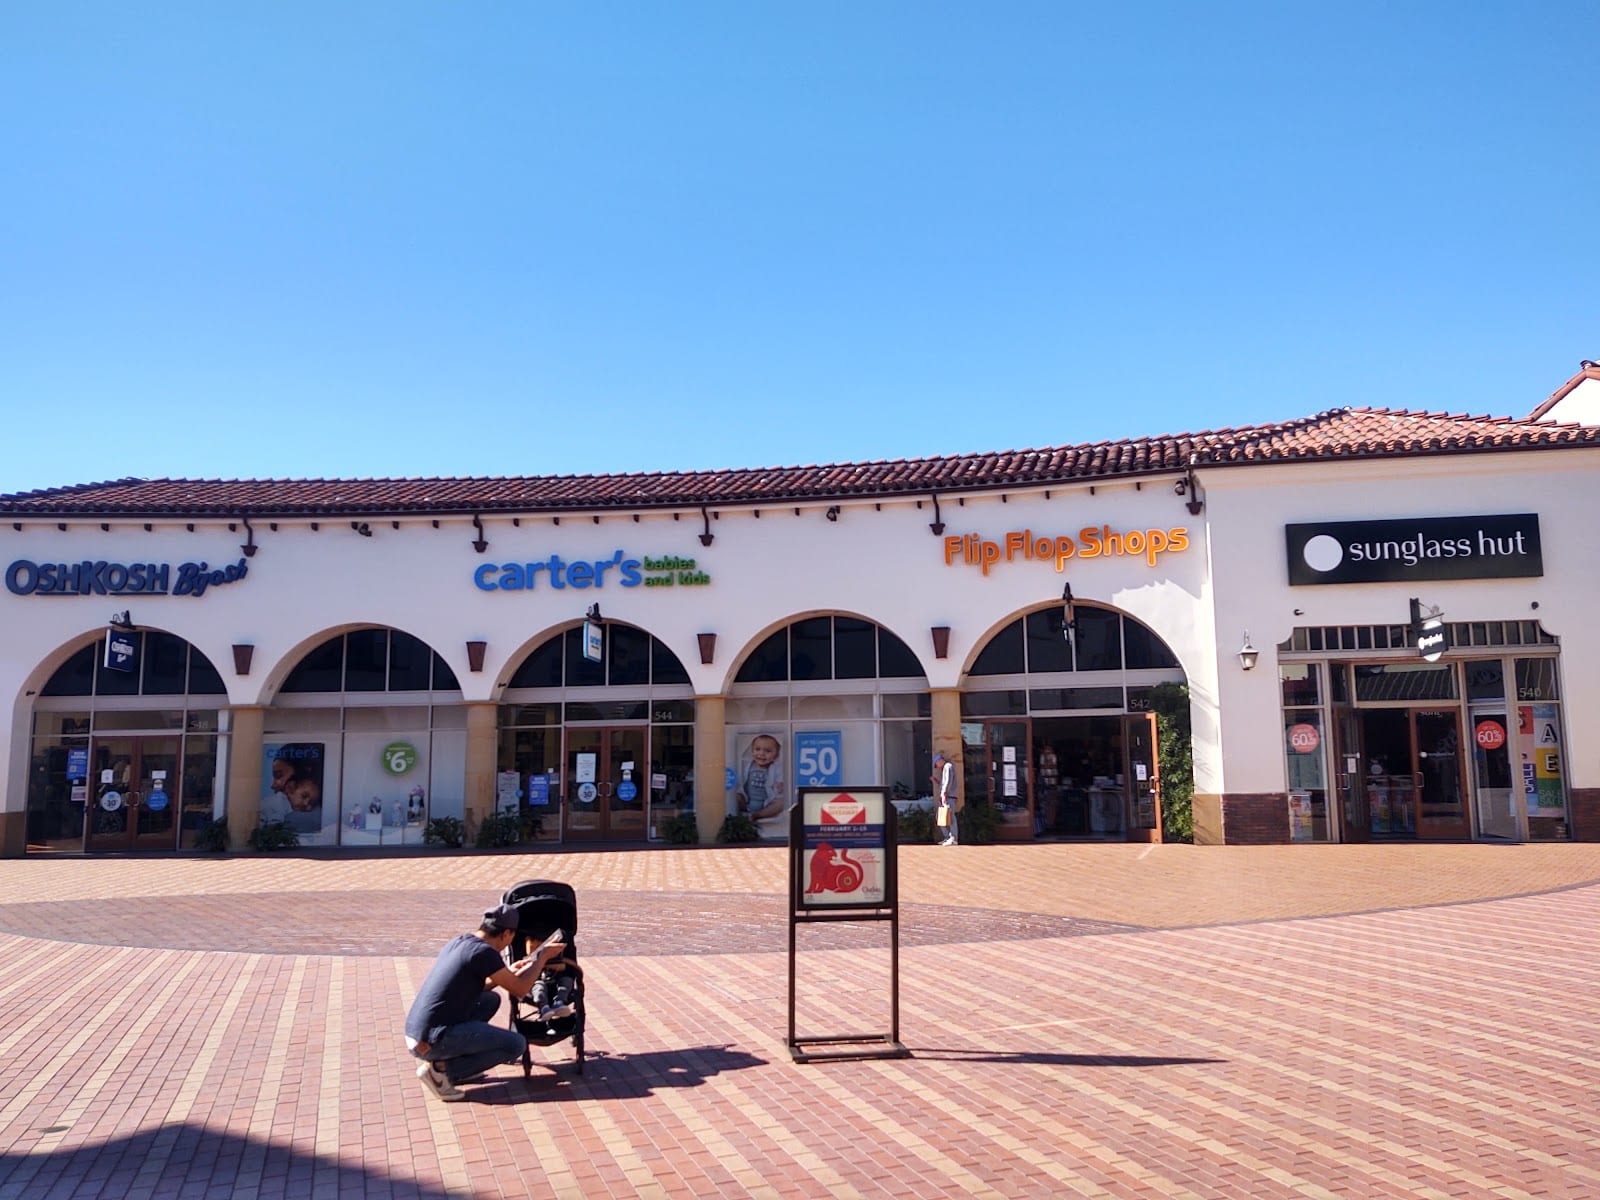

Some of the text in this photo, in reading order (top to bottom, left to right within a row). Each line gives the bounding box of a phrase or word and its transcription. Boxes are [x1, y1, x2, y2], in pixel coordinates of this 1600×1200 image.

[944, 524, 1189, 576] Flip Flop Shops
[1350, 530, 1527, 566] sunglass hut
[474, 549, 643, 592] carter's
[643, 555, 696, 571] babies
[644, 570, 712, 587] and kids
[1519, 687, 1541, 698] 540
[1130, 699, 1150, 709] 542
[655, 711, 673, 720] 544
[1542, 724, 1558, 743] A
[266, 746, 320, 759] carter's
[799, 747, 839, 776] 50
